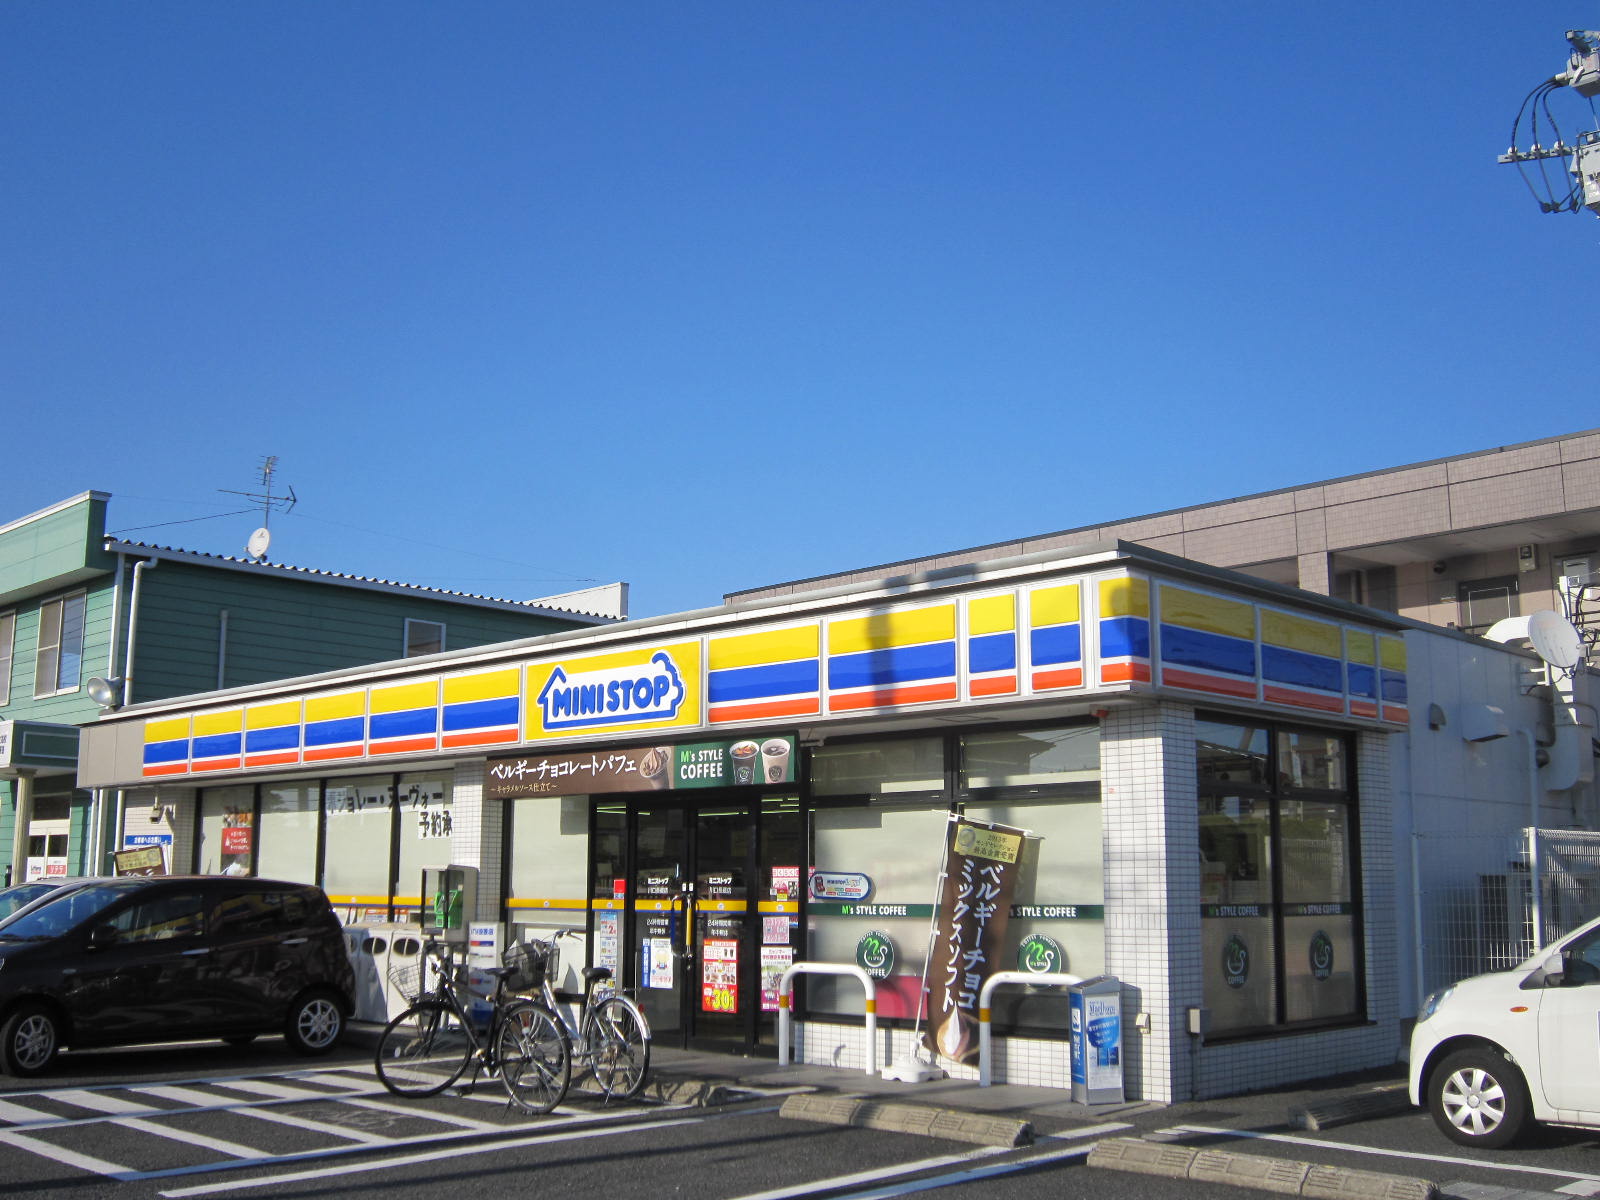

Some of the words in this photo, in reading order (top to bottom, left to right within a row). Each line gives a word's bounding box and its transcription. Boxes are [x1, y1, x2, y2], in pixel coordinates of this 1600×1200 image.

[552, 675, 670, 717] MINISTOP
[681, 751, 696, 762] M's
[698, 748, 723, 761] STYLE
[490, 755, 637, 780] ベルギーチョコレートパフェ
[681, 762, 723, 779] COFFEE
[841, 905, 853, 914] M's
[856, 905, 876, 915] STYLE
[879, 905, 907, 915] COFFEE
[1016, 906, 1041, 917] STYLE
[1043, 906, 1077, 917] COFFEE
[1220, 905, 1237, 916] STYLE
[1238, 905, 1259, 916] COFFEE
[1307, 904, 1322, 914] STYLE
[1322, 903, 1341, 913] COFFEE
[943, 858, 975, 1013] ミックスソフト
[958, 864, 1004, 1009] ベルギーチョコ
